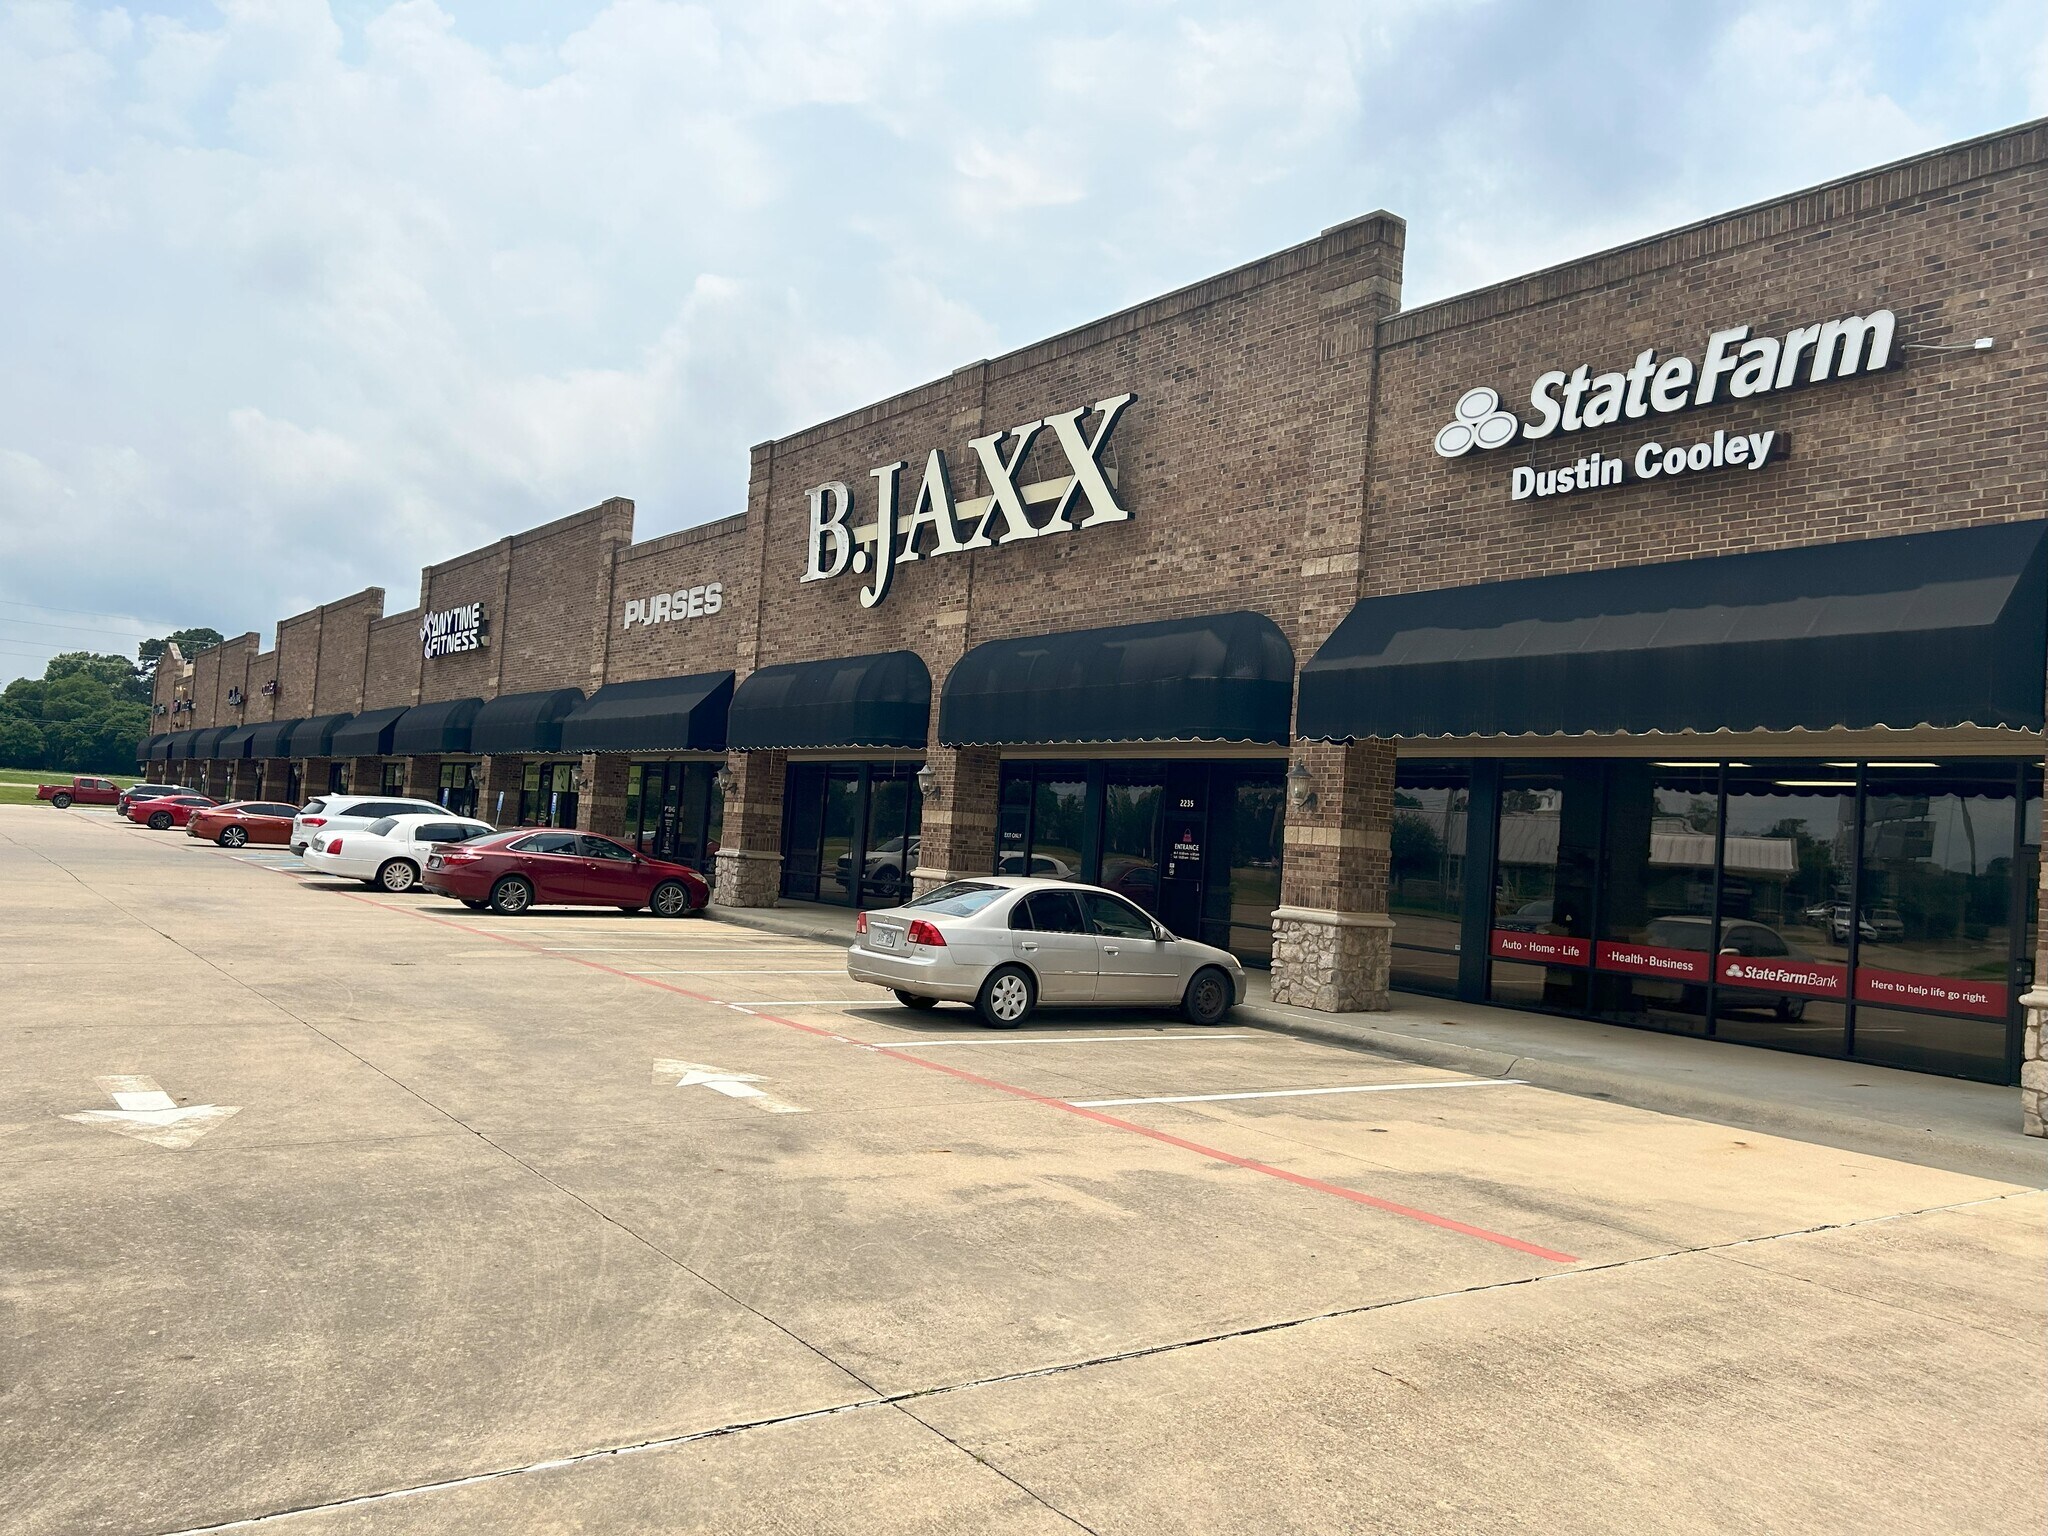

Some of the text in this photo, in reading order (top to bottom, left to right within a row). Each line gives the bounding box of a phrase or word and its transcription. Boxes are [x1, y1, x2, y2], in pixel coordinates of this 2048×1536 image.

[1512, 430, 1775, 500] Dustin Cooley
[624, 582, 722, 629] PURSES
[431, 602, 480, 637] ANYTIME
[430, 629, 478, 656] FITNESS
[1180, 799, 1194, 808] 2235
[1174, 843, 1200, 851] ENTRANCE
[1502, 939, 1580, 957] Auto Home Life
[1611, 951, 1694, 971] Health Business
[1871, 979, 1989, 1003] Here to help life go right.
